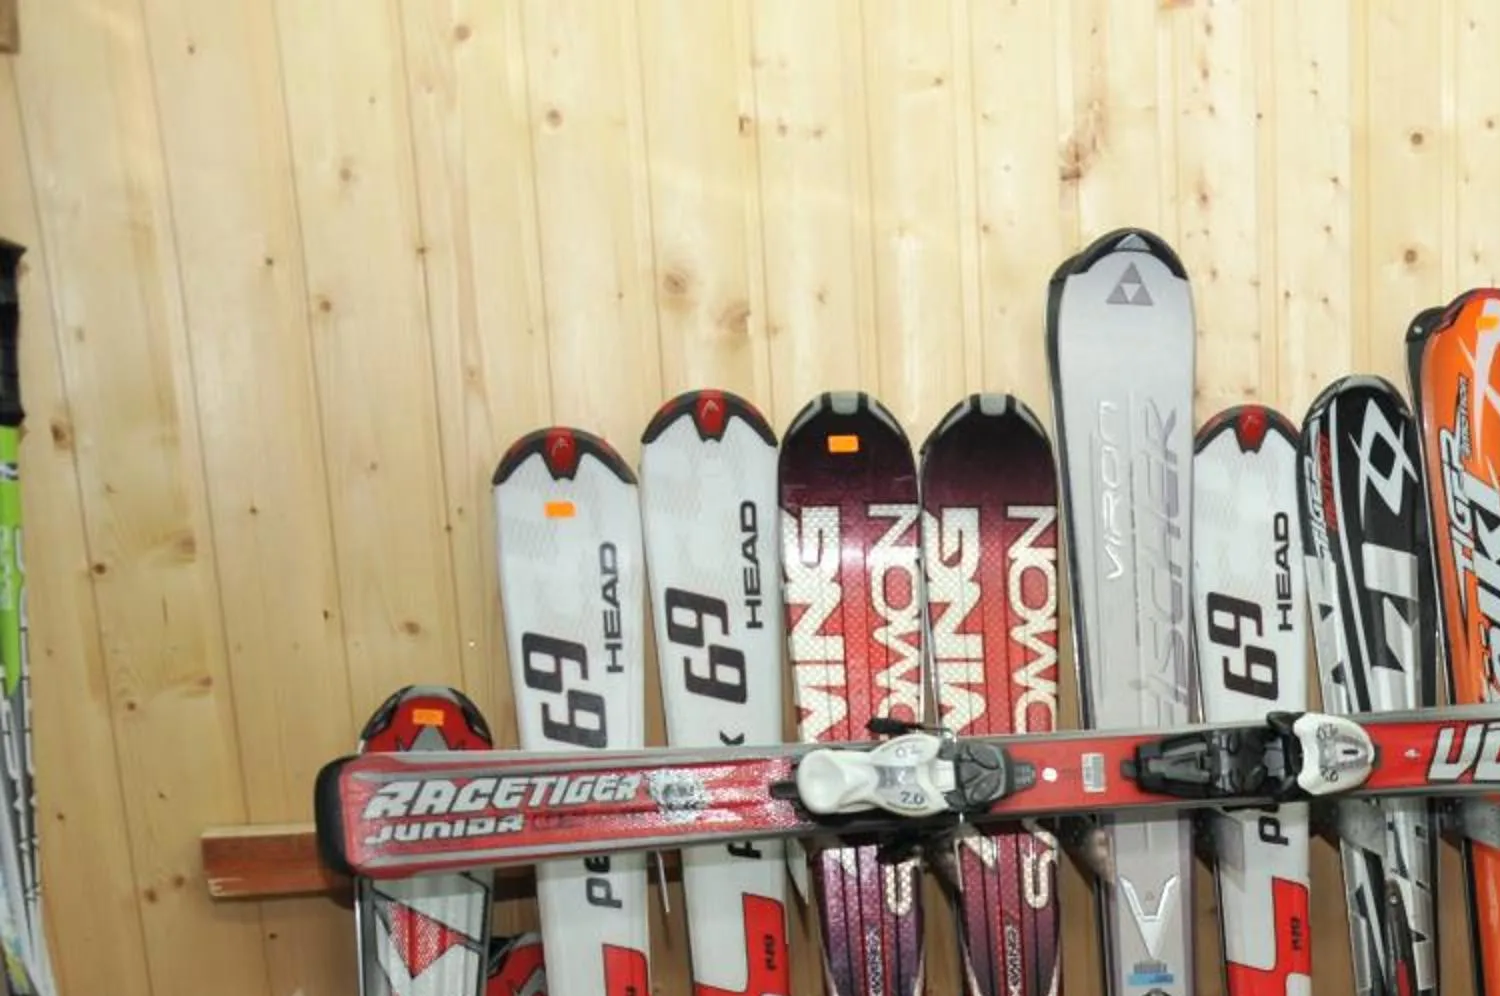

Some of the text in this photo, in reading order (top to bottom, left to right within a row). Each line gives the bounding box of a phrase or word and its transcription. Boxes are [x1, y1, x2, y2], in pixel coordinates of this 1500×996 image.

[1302, 453, 1334, 562] TIGER
[1440, 428, 1474, 578] TIGER
[599, 542, 624, 673] HEAD
[741, 500, 764, 629] HEAD
[1273, 511, 1293, 631] HEAD
[521, 632, 609, 748] 69
[665, 587, 748, 704] 69
[1207, 591, 1279, 701] 69
[364, 774, 643, 819] RACETIGER
